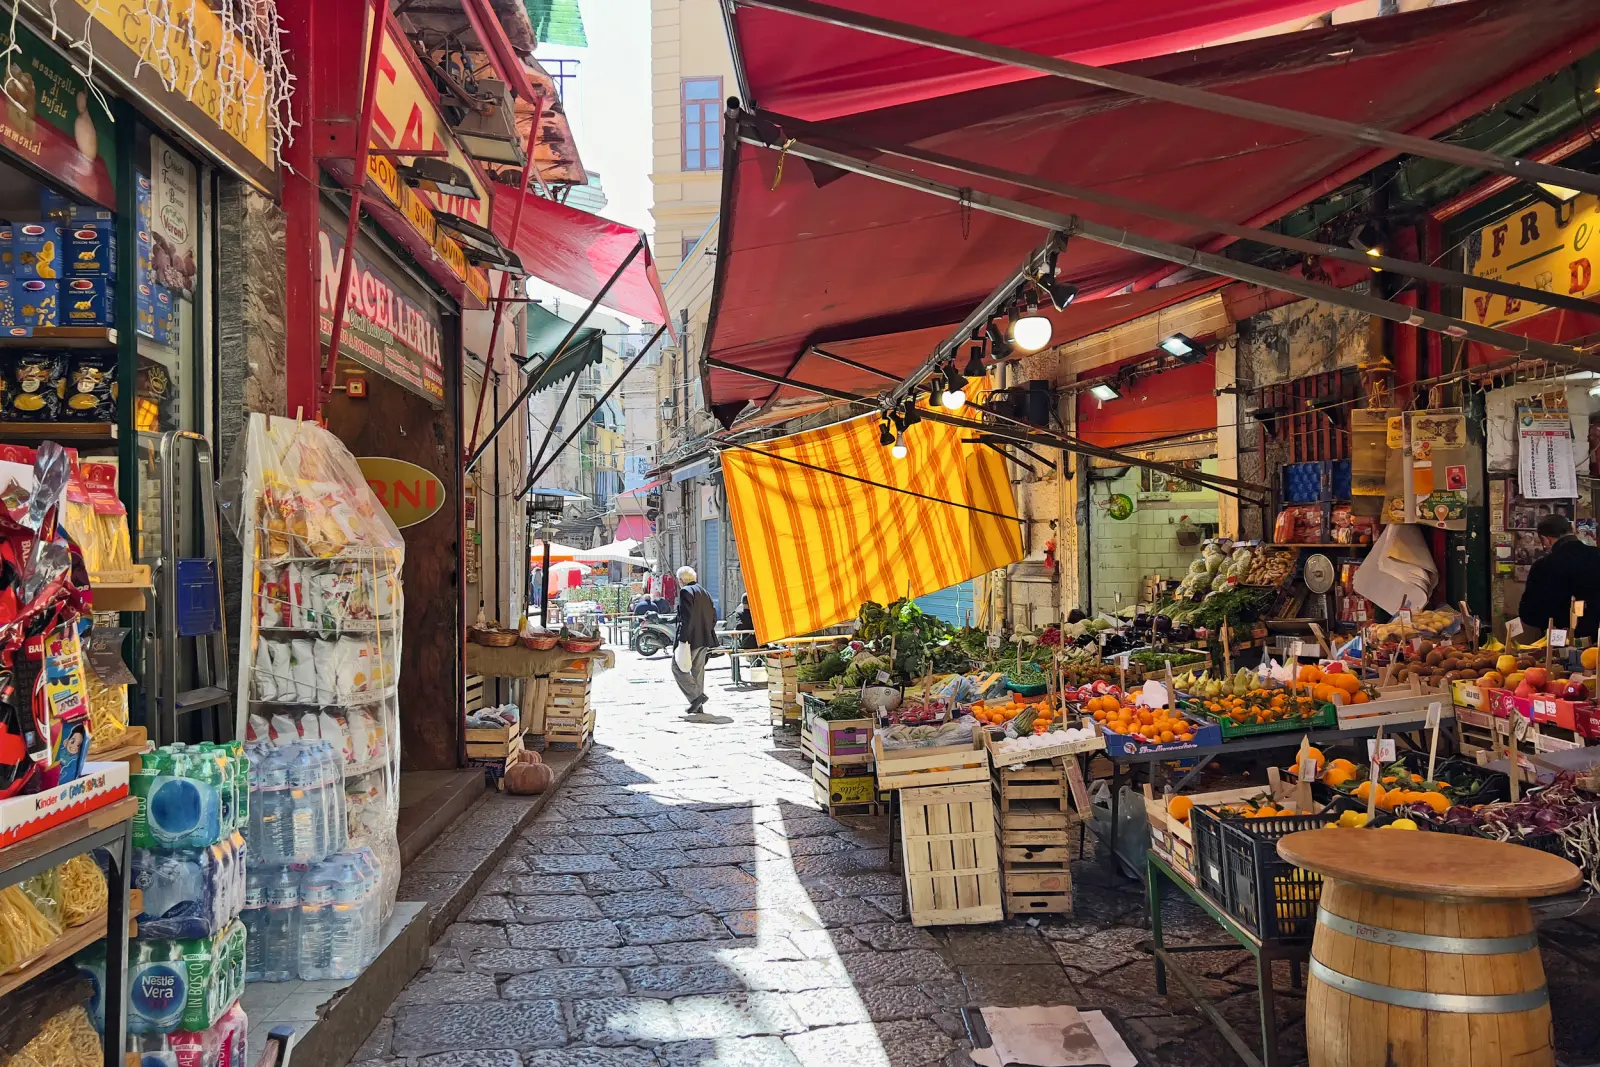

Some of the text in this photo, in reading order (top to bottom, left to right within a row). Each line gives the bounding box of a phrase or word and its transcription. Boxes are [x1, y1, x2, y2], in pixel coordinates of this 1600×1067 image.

[163, 214, 184, 241] Veroni
[318, 230, 443, 372] MACELLERIA
[35, 795, 58, 811] Kinder
[142, 986, 175, 999] Vera
[188, 963, 204, 995] BOSCO
